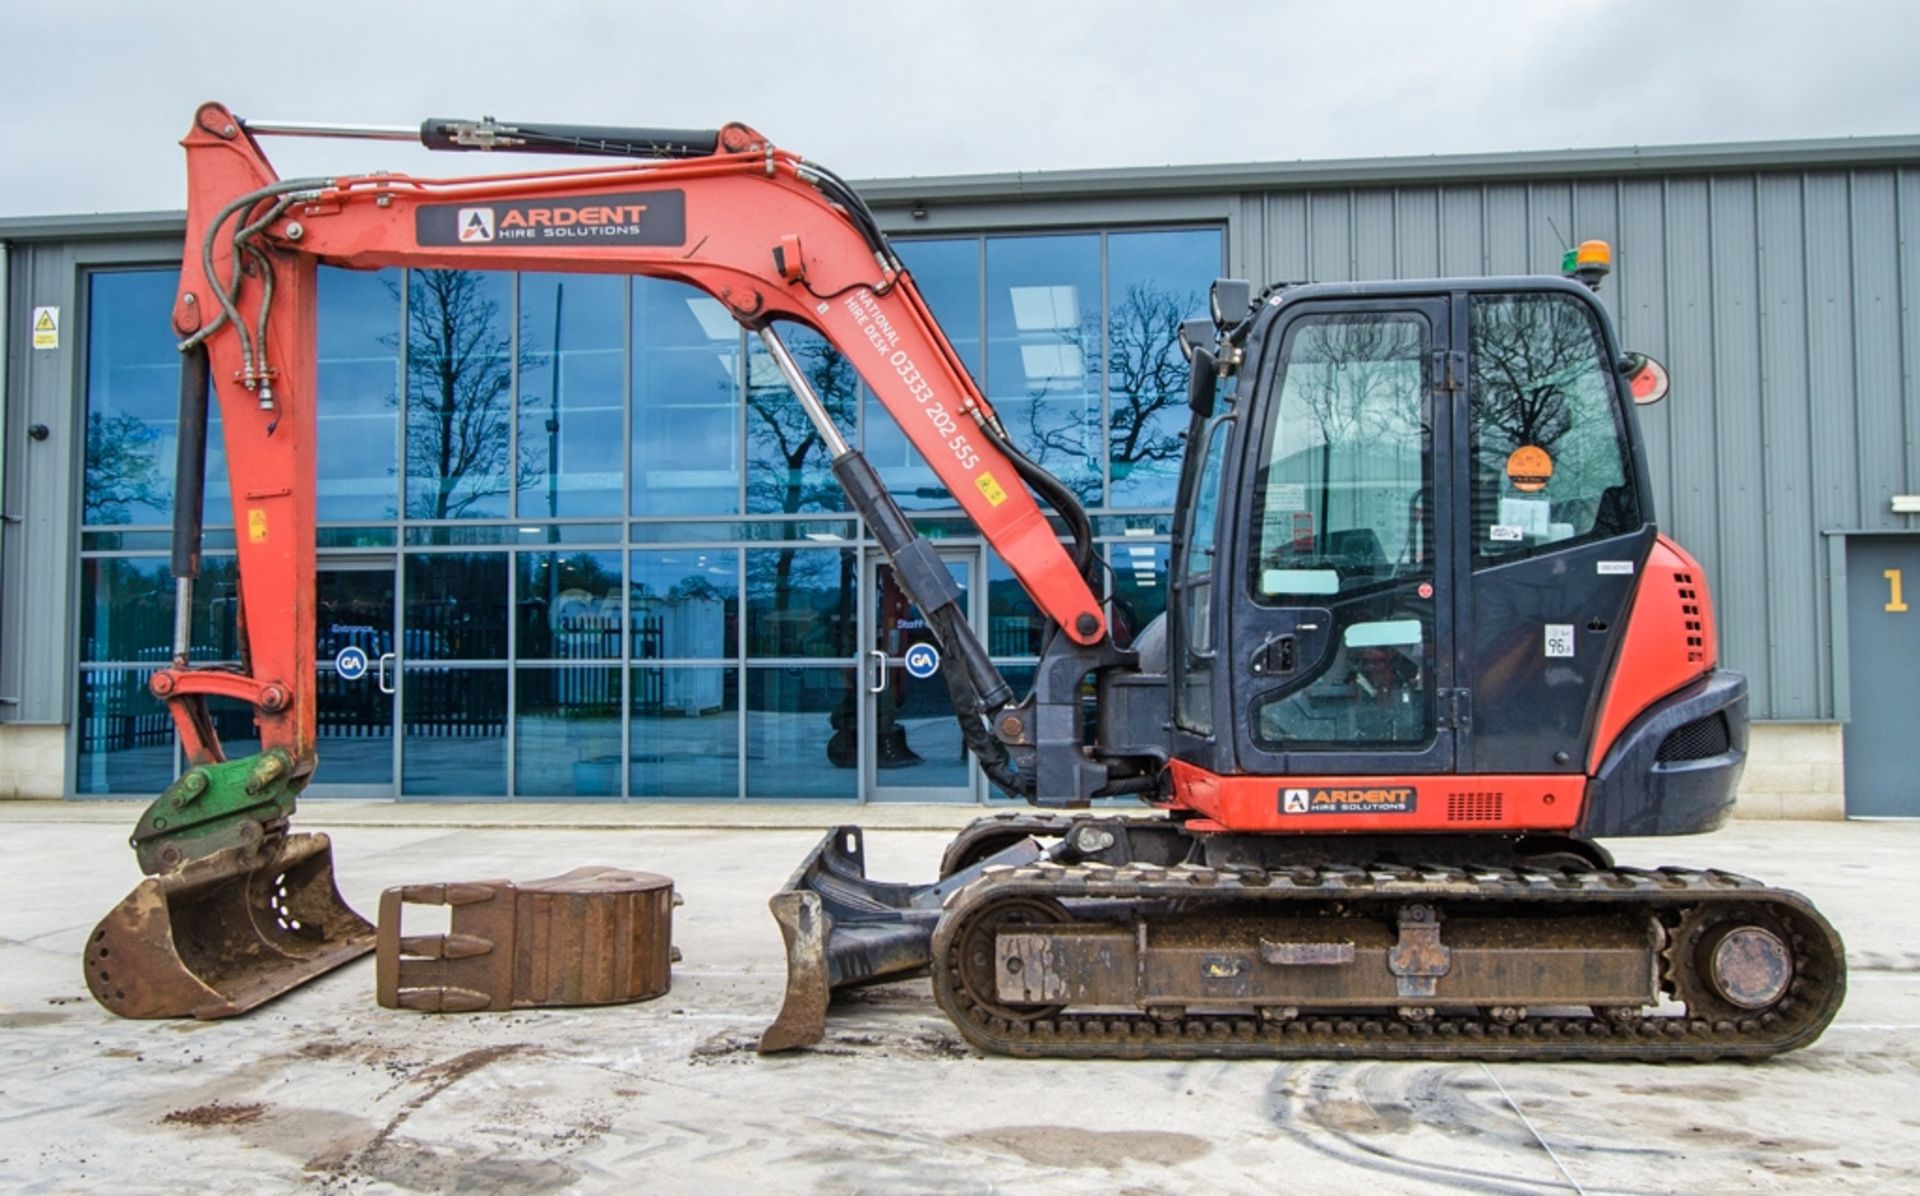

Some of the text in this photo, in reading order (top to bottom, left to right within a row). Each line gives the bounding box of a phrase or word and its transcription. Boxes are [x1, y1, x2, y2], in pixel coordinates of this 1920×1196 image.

[499, 225, 641, 239] HIRE SOLUTIONS
[500, 205, 647, 227] ARDENT
[845, 297, 891, 356] HIRE DESK
[856, 289, 900, 347] NATIONAL
[890, 351, 980, 470] 03333 202 555
[1884, 569, 1908, 612] 1
[1311, 803, 1406, 811] HIRE SOLUTIONS
[1312, 790, 1412, 803] ARDENT
